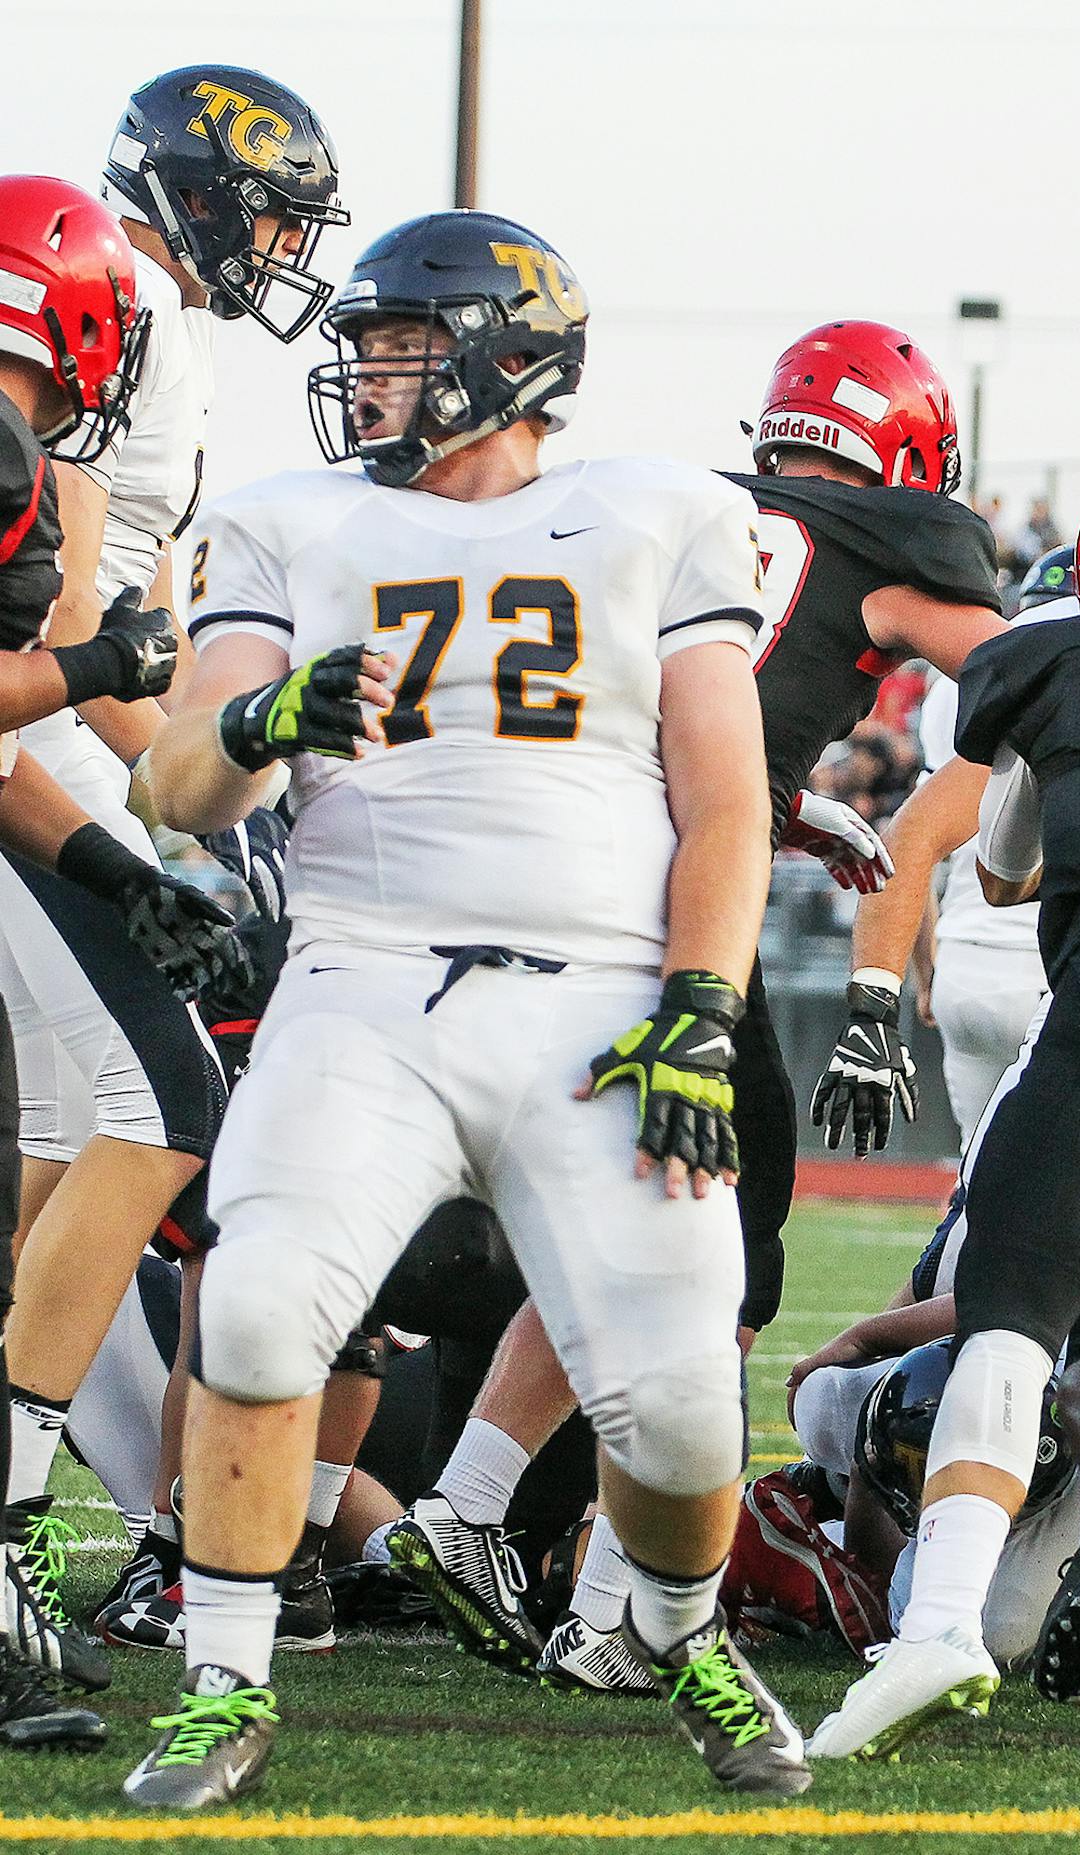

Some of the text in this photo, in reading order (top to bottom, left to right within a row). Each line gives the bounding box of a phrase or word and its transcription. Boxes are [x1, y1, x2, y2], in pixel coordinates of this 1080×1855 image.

[186, 80, 294, 173] TG
[760, 418, 840, 449] Riddell
[372, 573, 587, 748] 72
